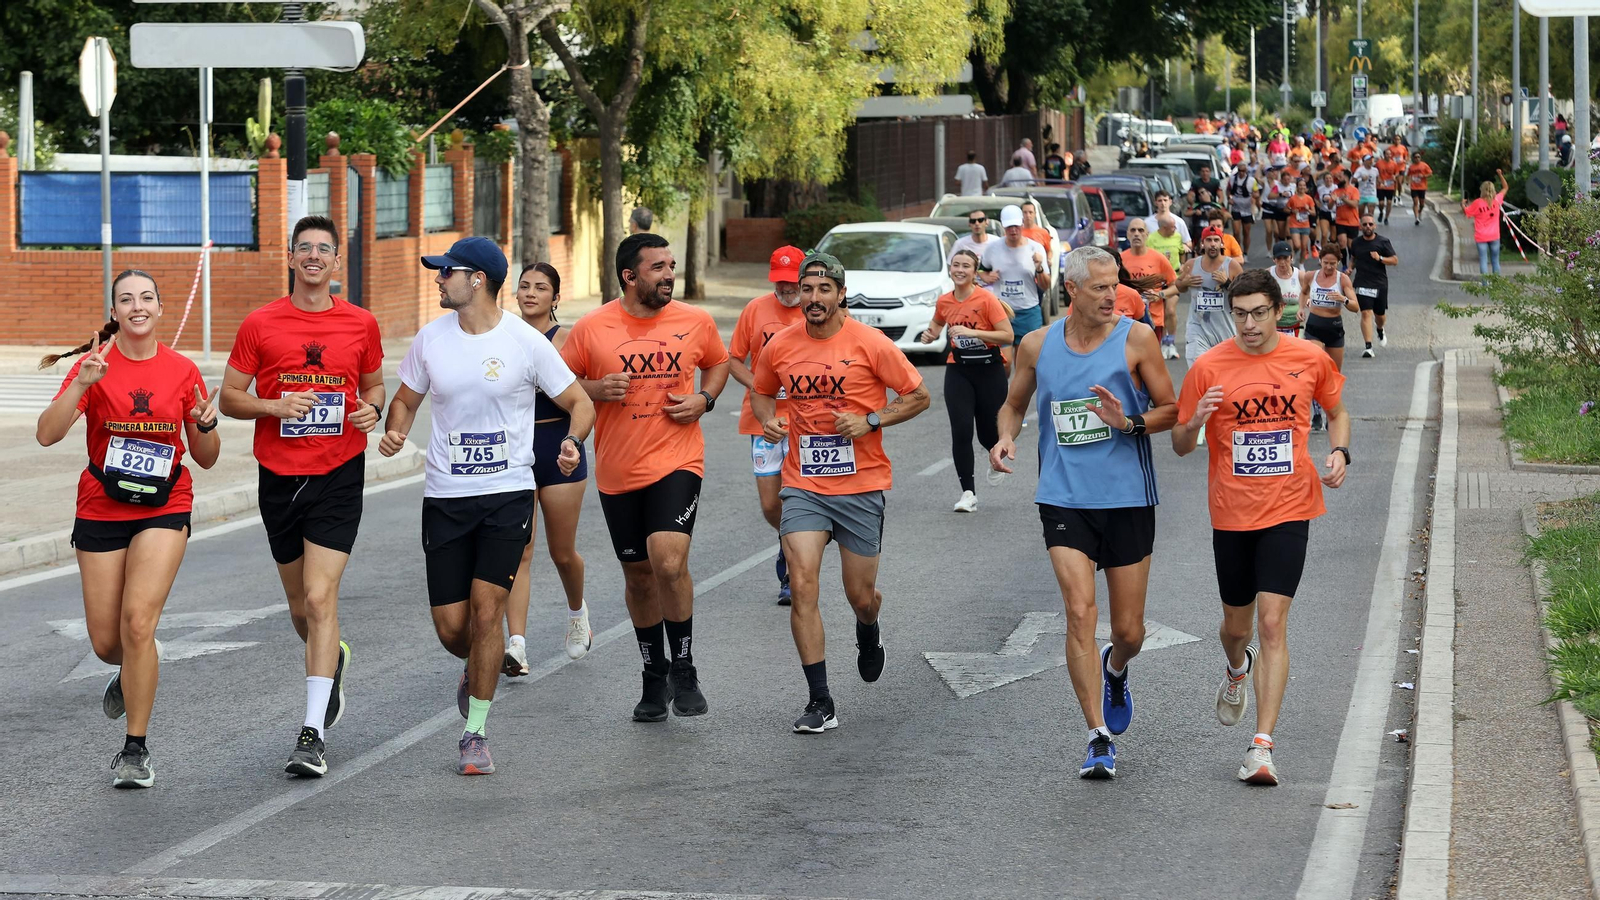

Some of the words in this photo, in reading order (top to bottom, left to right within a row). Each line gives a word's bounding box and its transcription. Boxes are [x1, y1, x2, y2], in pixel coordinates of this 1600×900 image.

[618, 351, 683, 374] XXIX
[282, 374, 313, 382] PRIMERA
[788, 374, 847, 395] XXIX
[1231, 394, 1298, 420] XXIX
[108, 422, 141, 431] PRIMERA
[143, 422, 174, 432] BATERIA
[1068, 414, 1089, 430] 17
[462, 447, 494, 462] 765
[811, 449, 841, 463] 892
[1246, 446, 1278, 462] 635
[121, 452, 156, 473] 820
